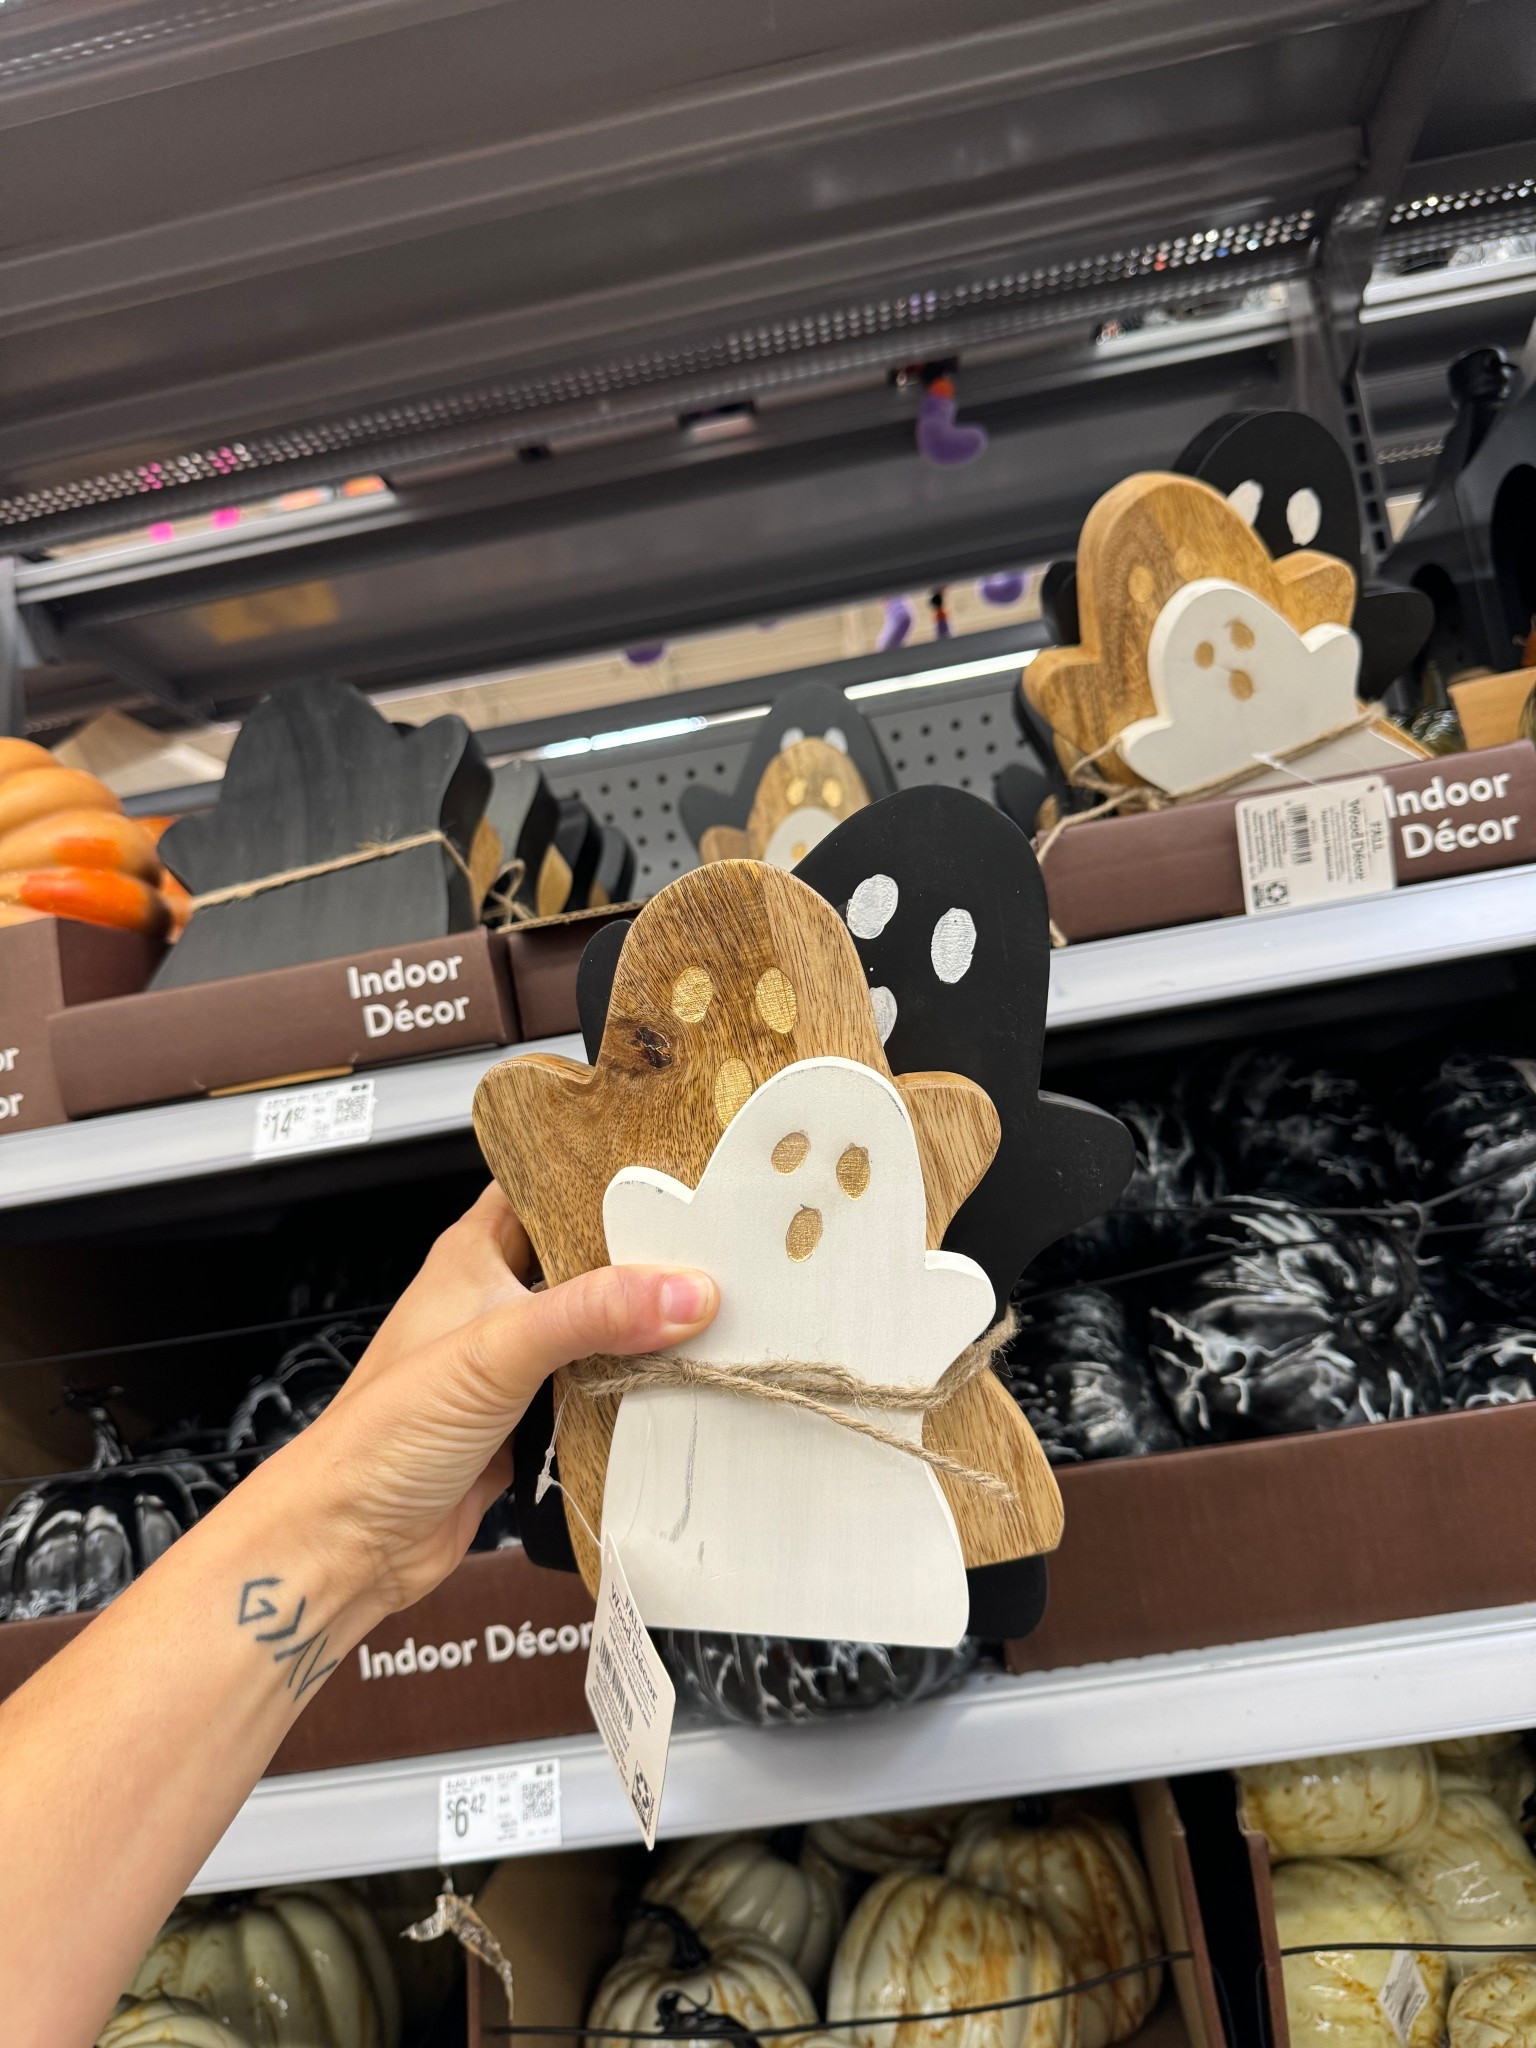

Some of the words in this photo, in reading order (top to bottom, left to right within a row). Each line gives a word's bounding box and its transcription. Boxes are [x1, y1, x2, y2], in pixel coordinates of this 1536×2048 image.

[1383, 773, 1511, 818] Indoor
[1401, 815, 1520, 859] Décor
[347, 956, 463, 1000] Indoor
[363, 995, 470, 1039] Décor
[358, 1637, 477, 1681] Indoor
[485, 1620, 594, 1664] Décor
[611, 1581, 632, 1645] Wood
[631, 1637, 658, 1702] Décor
